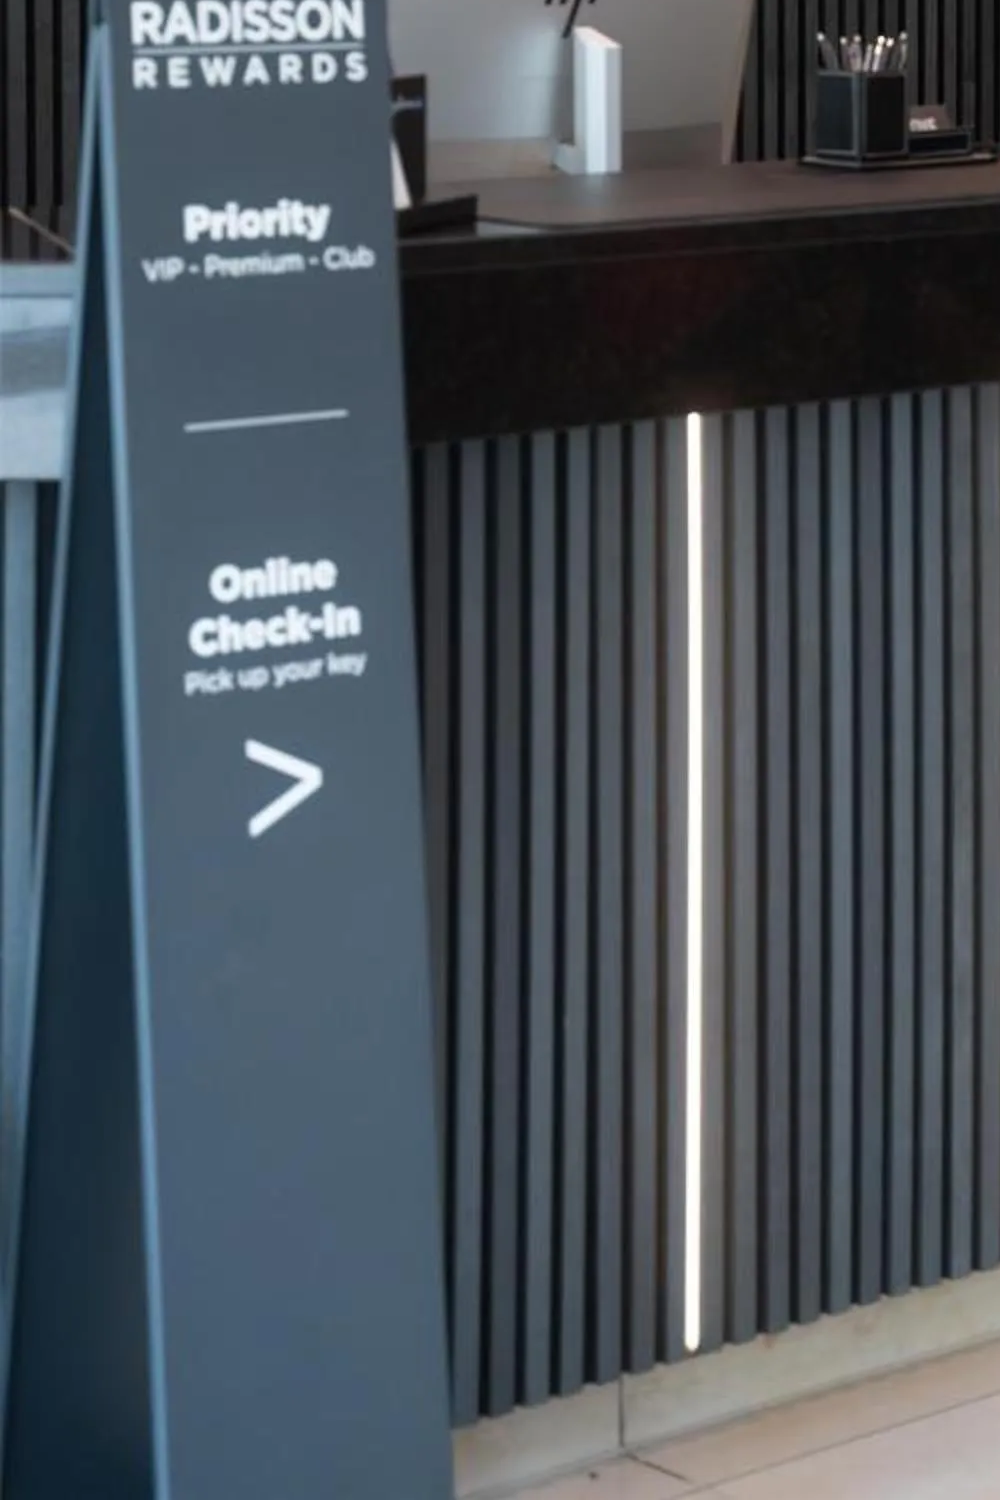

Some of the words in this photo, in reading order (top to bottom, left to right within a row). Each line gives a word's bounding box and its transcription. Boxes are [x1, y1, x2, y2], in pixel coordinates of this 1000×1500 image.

[132, 52, 368, 90] REWARDS
[182, 198, 331, 243] Priority
[142, 257, 184, 282] VIP
[204, 250, 305, 278] Premium
[323, 244, 376, 271] Club
[209, 556, 338, 603] Online
[184, 667, 234, 696] Pick
[238, 666, 269, 689] up
[273, 658, 323, 688] your
[327, 651, 368, 676] key
